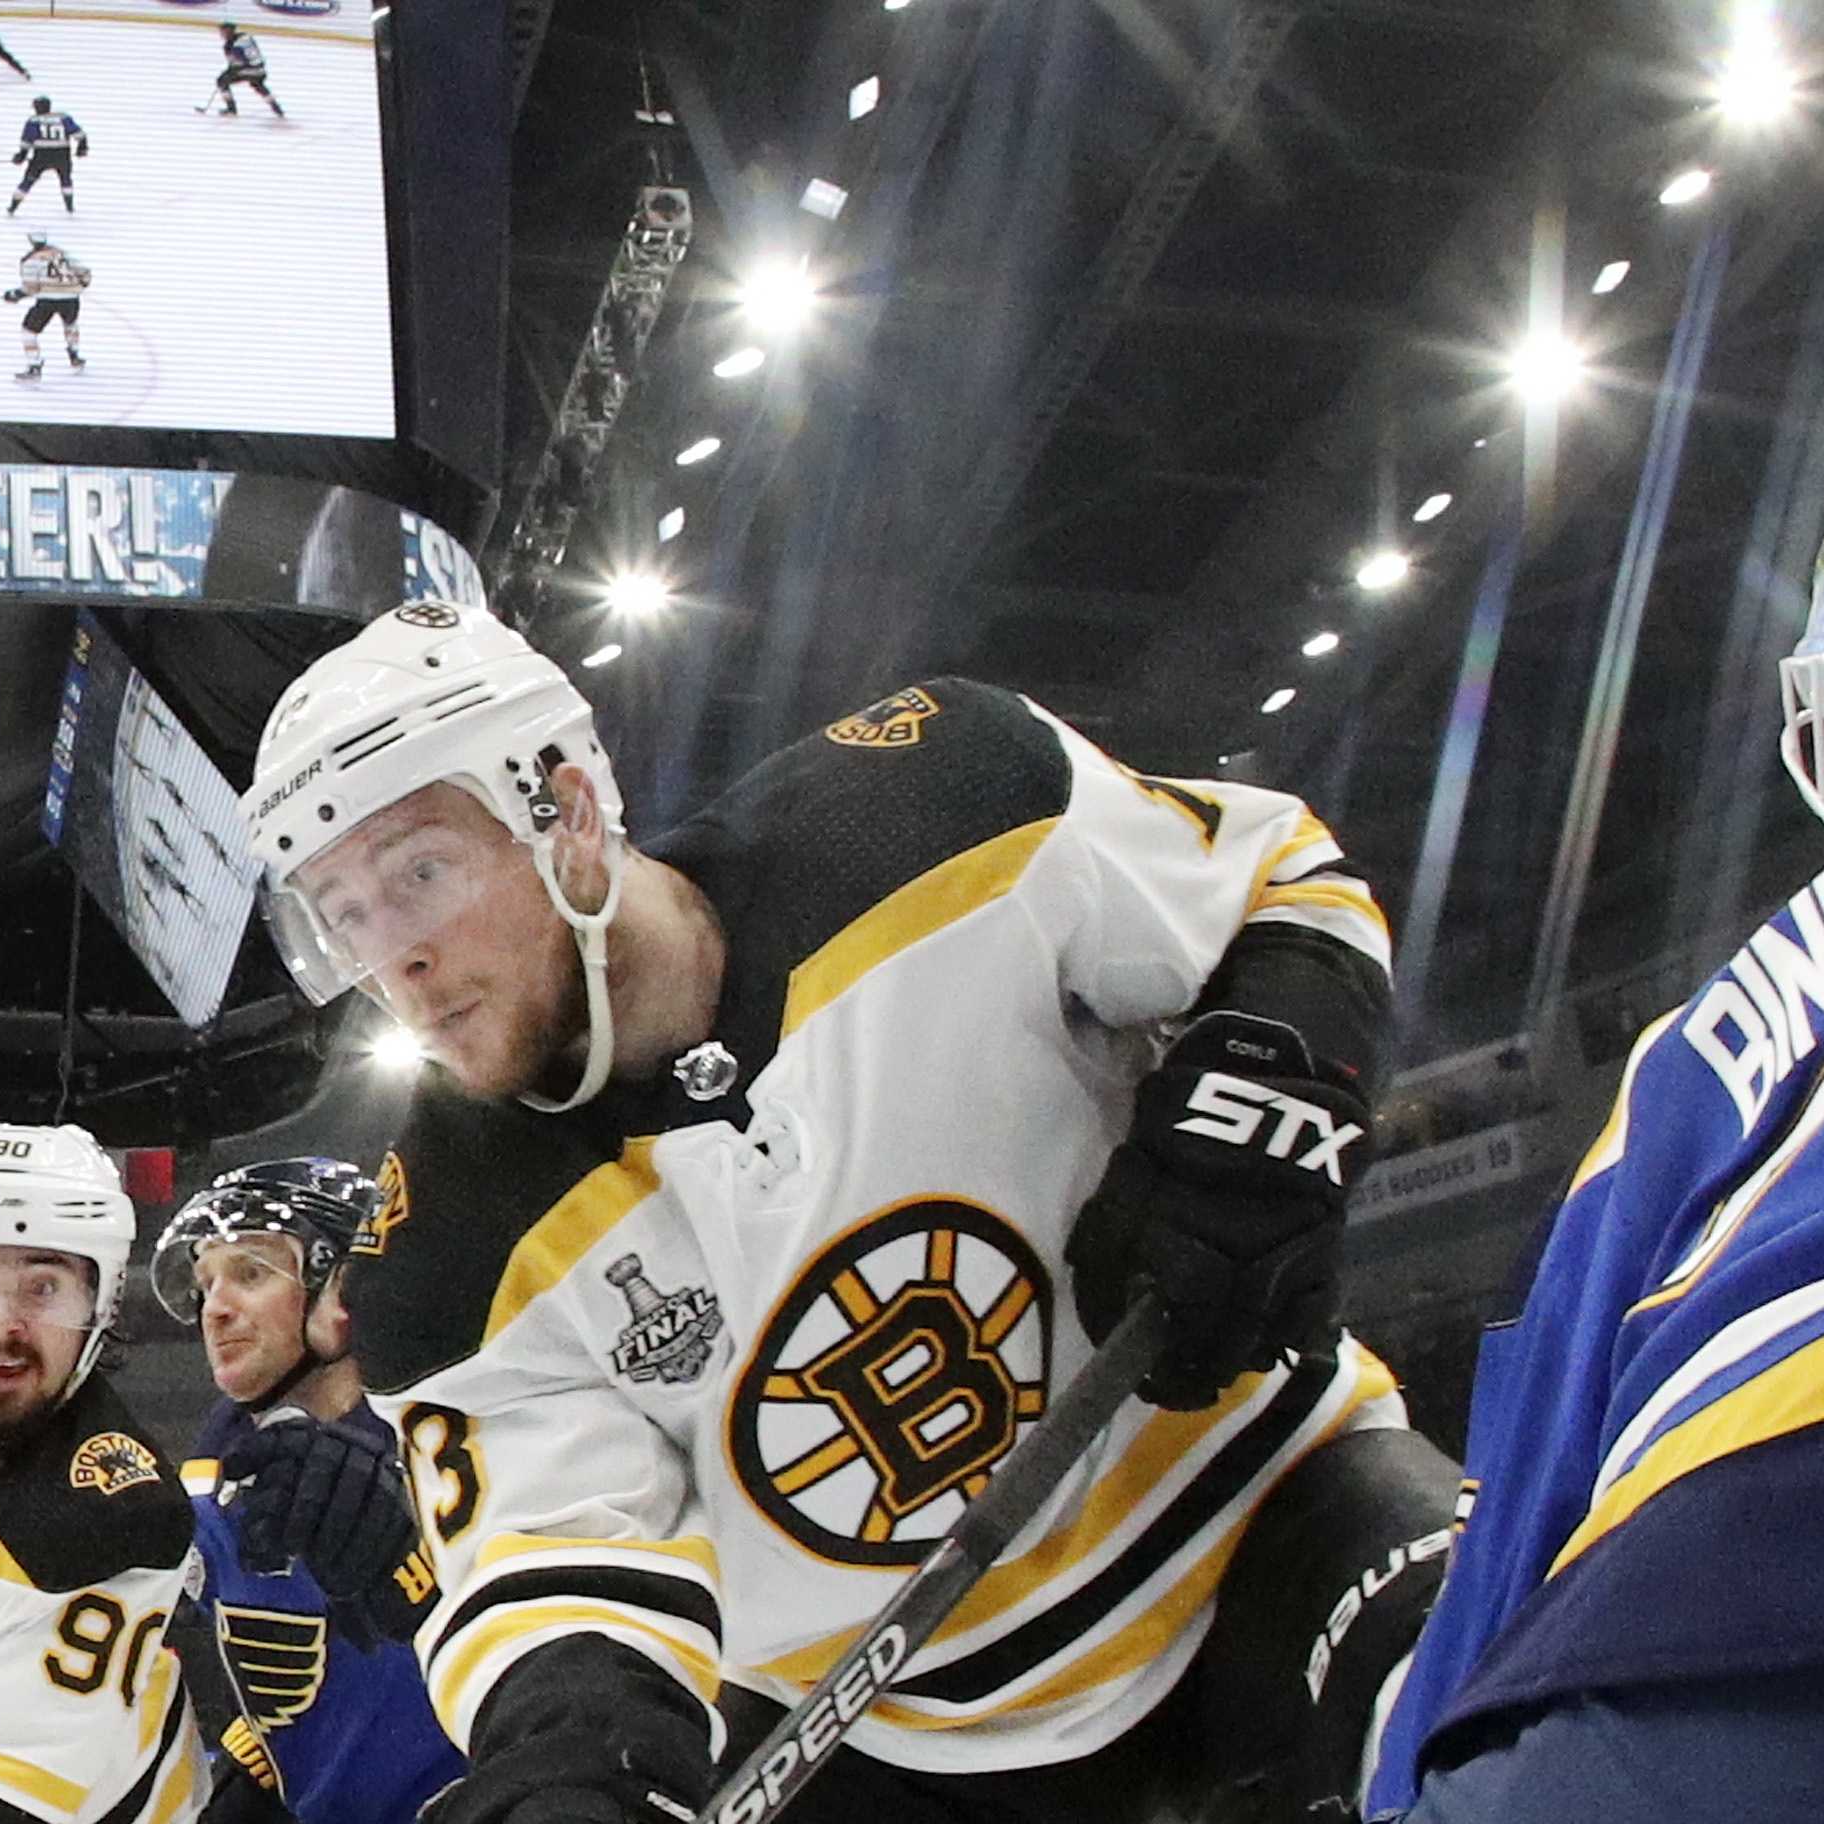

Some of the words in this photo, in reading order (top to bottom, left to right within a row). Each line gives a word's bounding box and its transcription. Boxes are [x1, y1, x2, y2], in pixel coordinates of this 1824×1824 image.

[1174, 1072, 1364, 1187] STX
[614, 1290, 717, 1373] FINAL
[73, 1434, 153, 1484] BOSTON
[1306, 1527, 1454, 1704] BAUE
